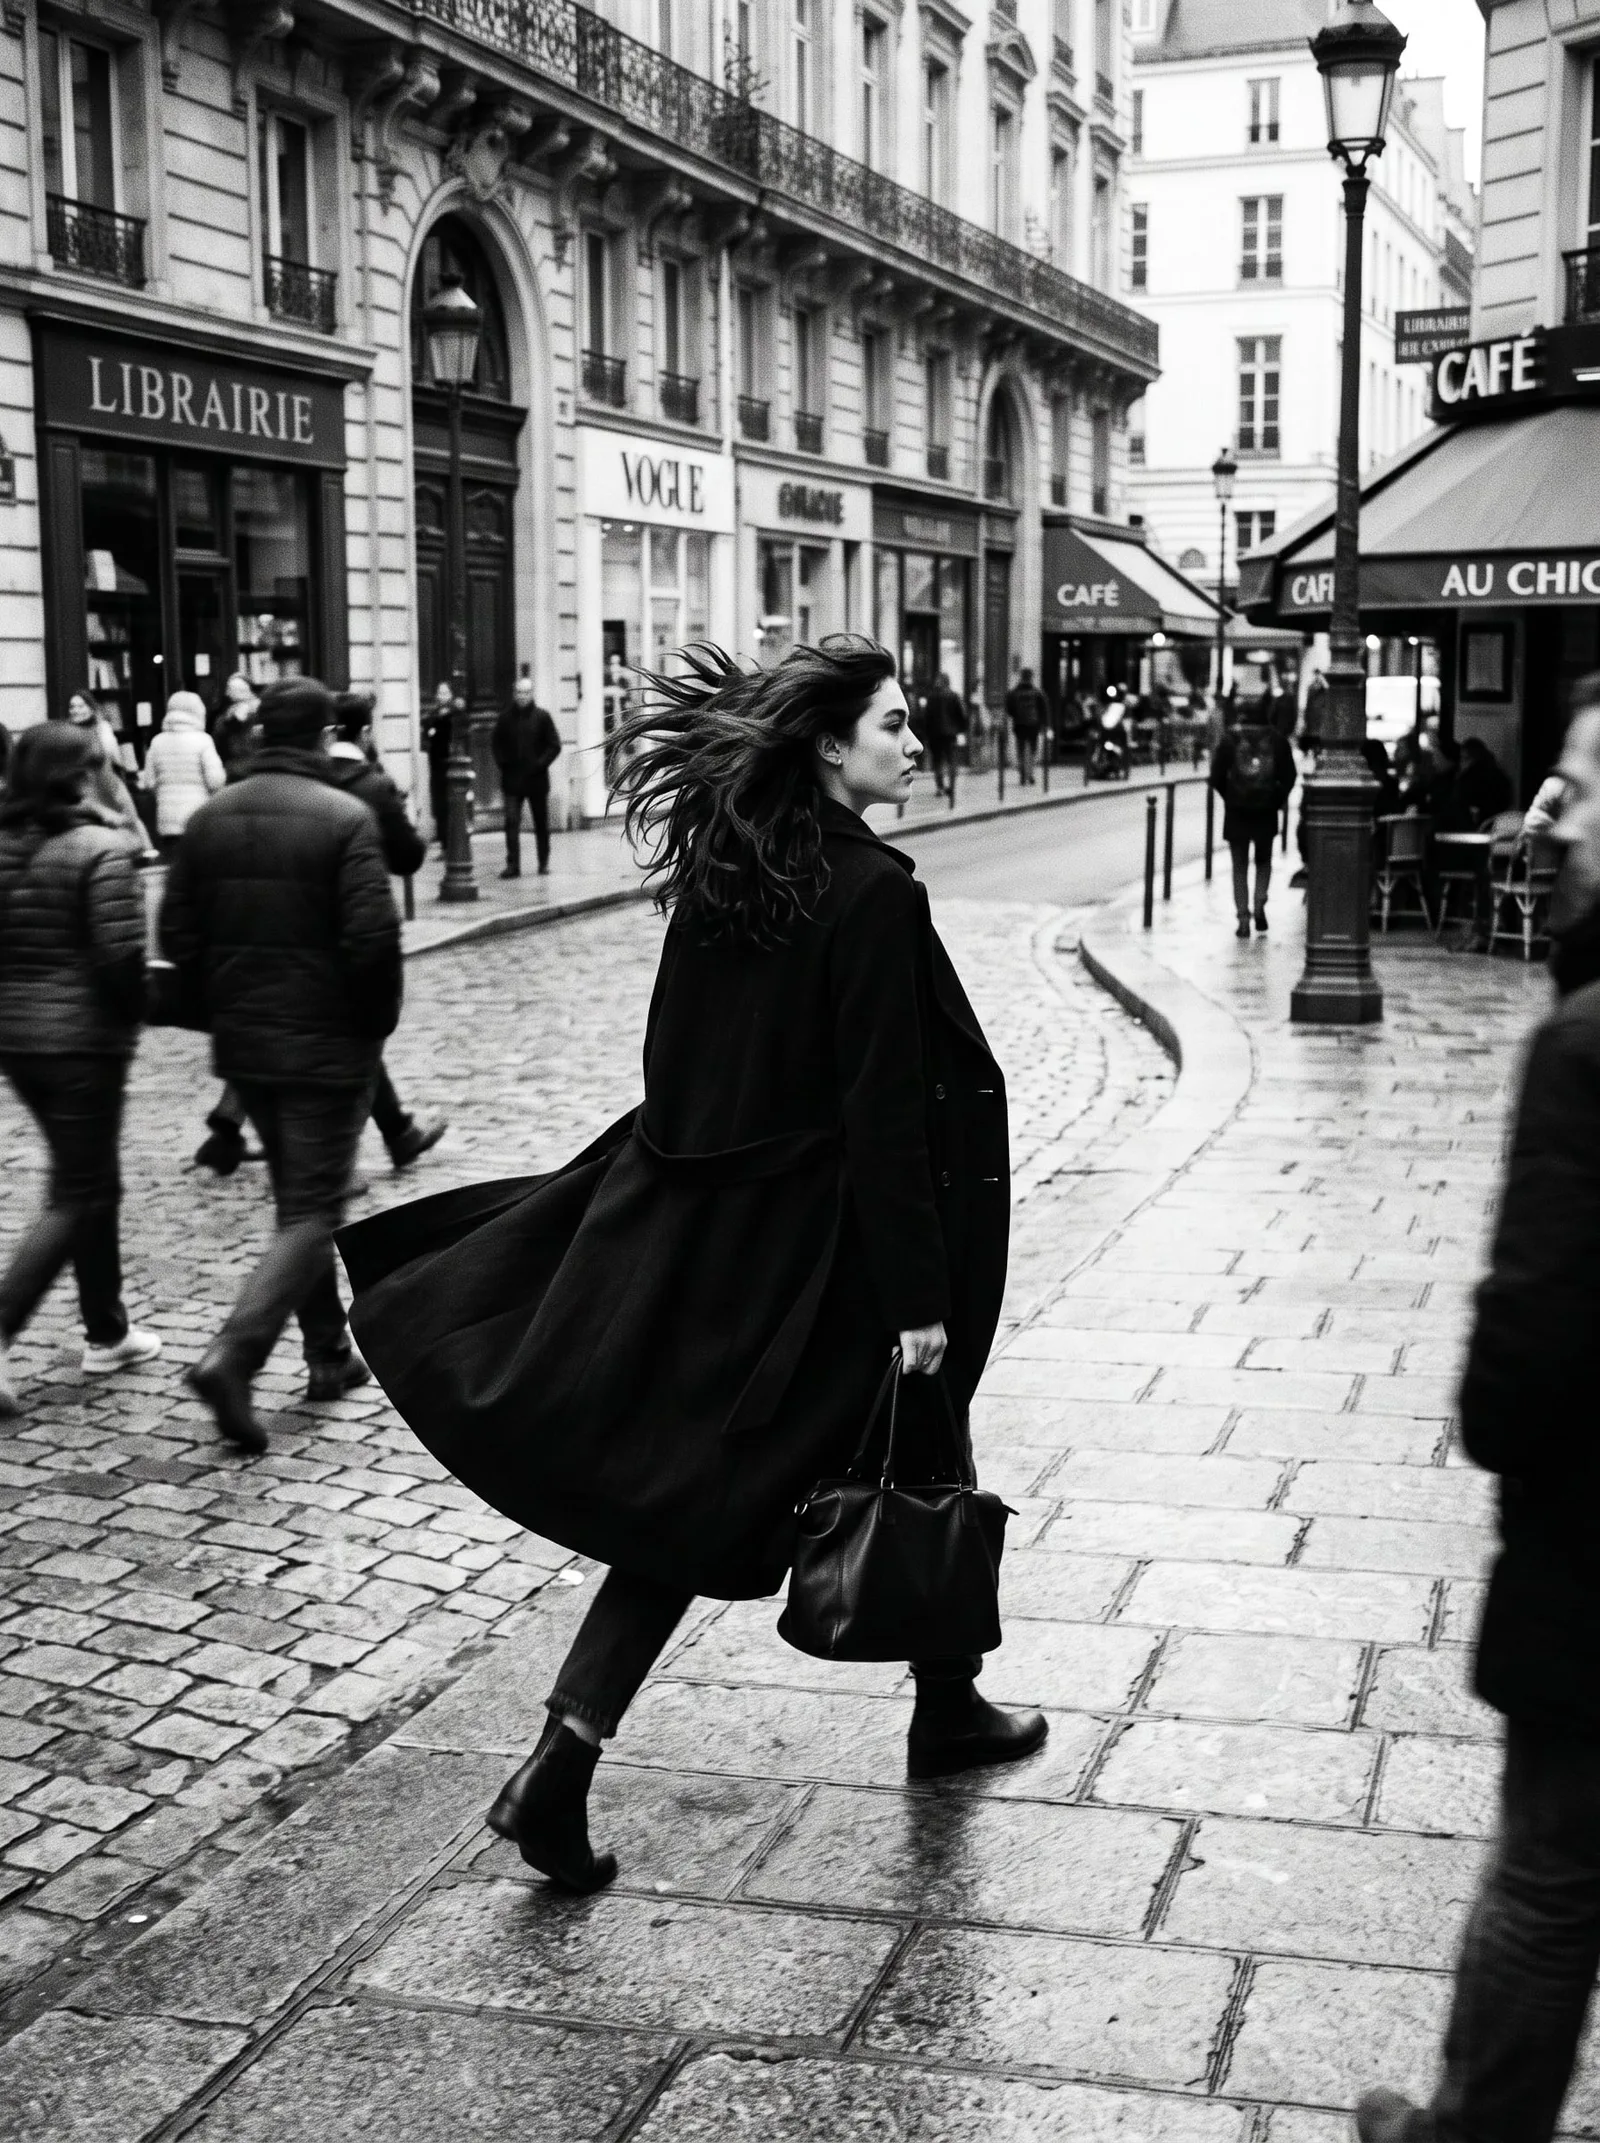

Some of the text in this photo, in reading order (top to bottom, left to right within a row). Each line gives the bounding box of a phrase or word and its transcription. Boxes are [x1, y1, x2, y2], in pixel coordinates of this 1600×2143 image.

[88, 356, 315, 445] LIBRAIRIE
[621, 451, 704, 513] VOGUE
[1057, 579, 1120, 607] CAFÉ
[1440, 563, 1494, 597] AU
